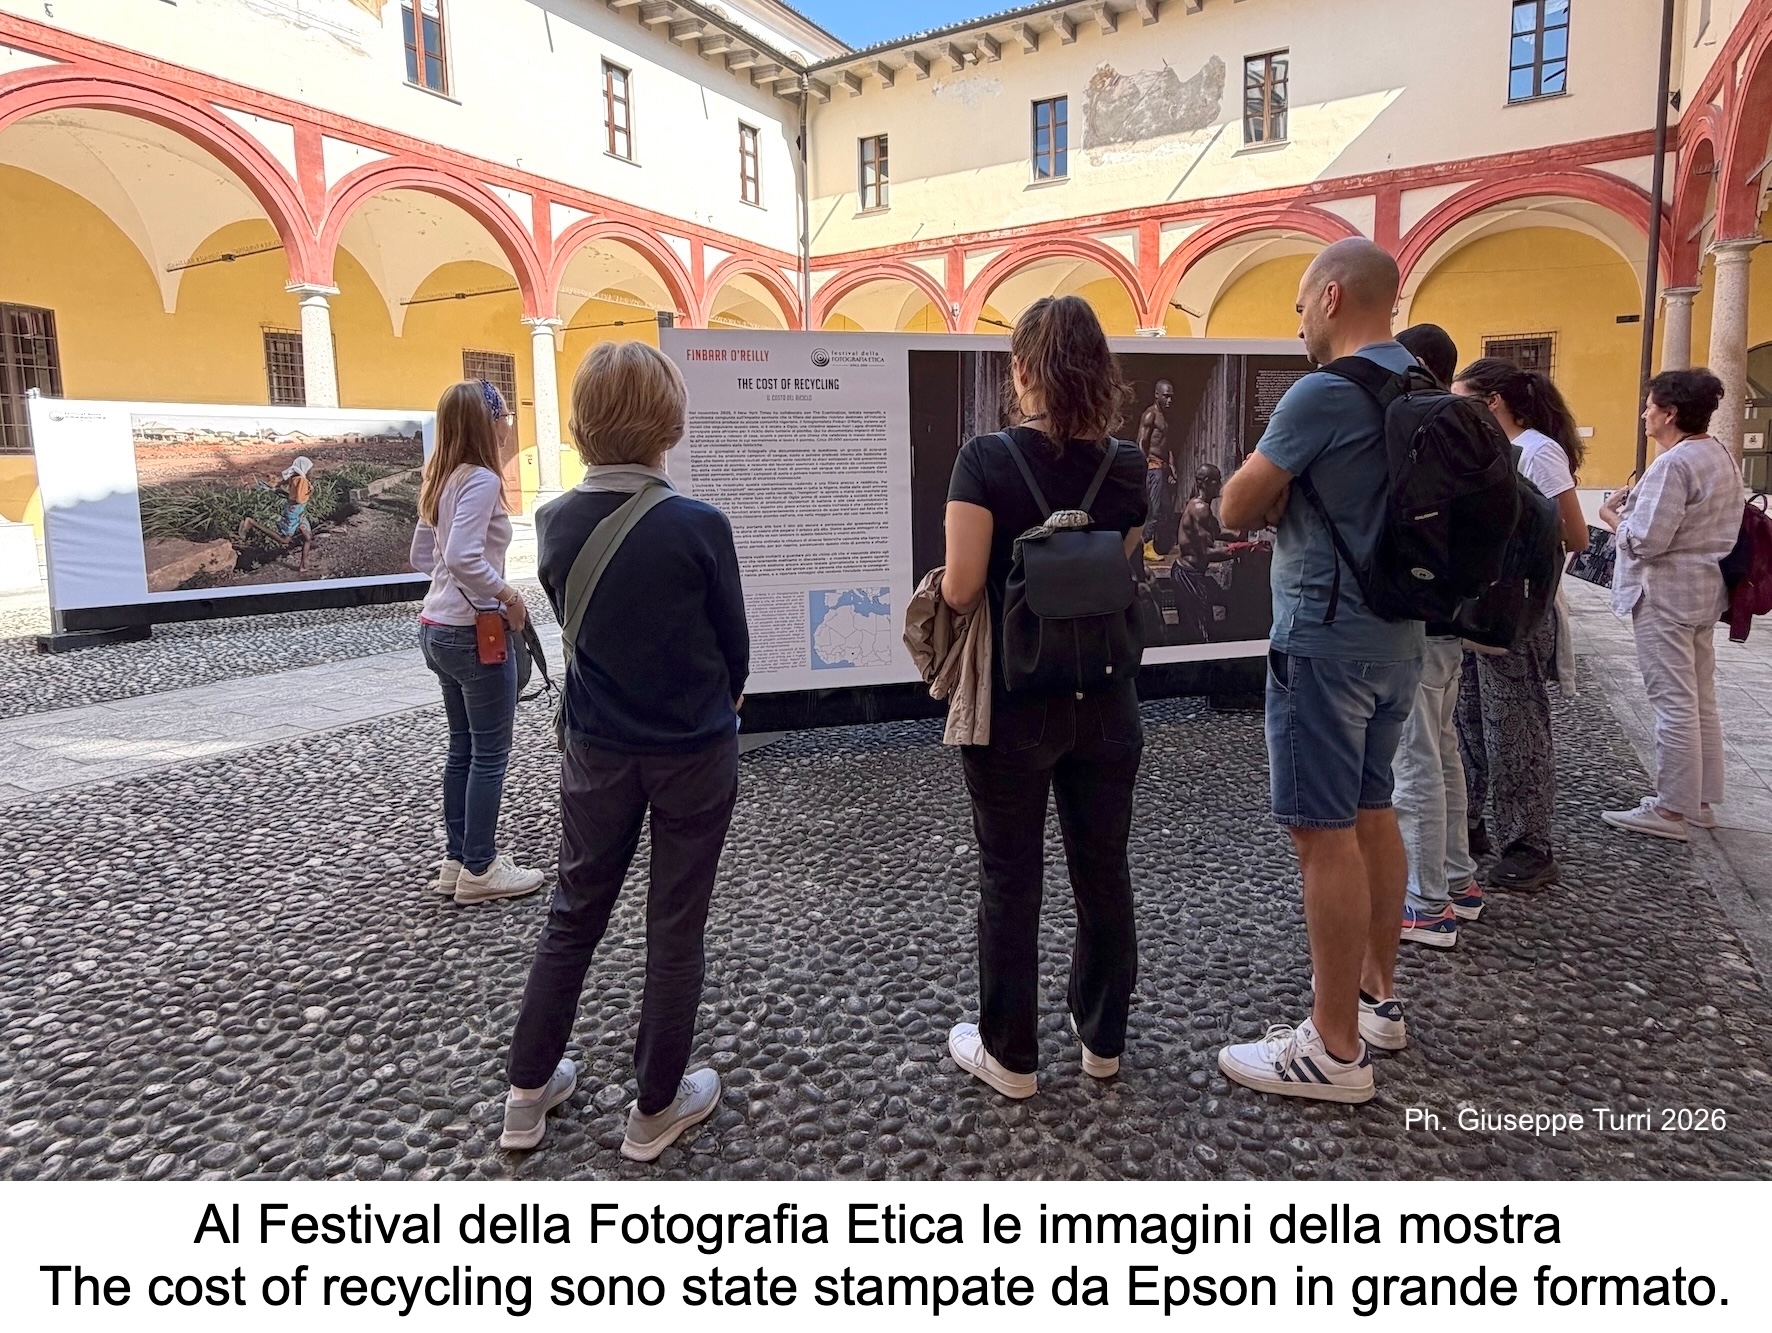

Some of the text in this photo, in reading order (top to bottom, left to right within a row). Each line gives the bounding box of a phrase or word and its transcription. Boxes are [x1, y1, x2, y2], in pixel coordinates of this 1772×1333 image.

[686, 349, 769, 362] FINBARR O'REILLY
[737, 378, 840, 390] THE COST OF RECYCLING
